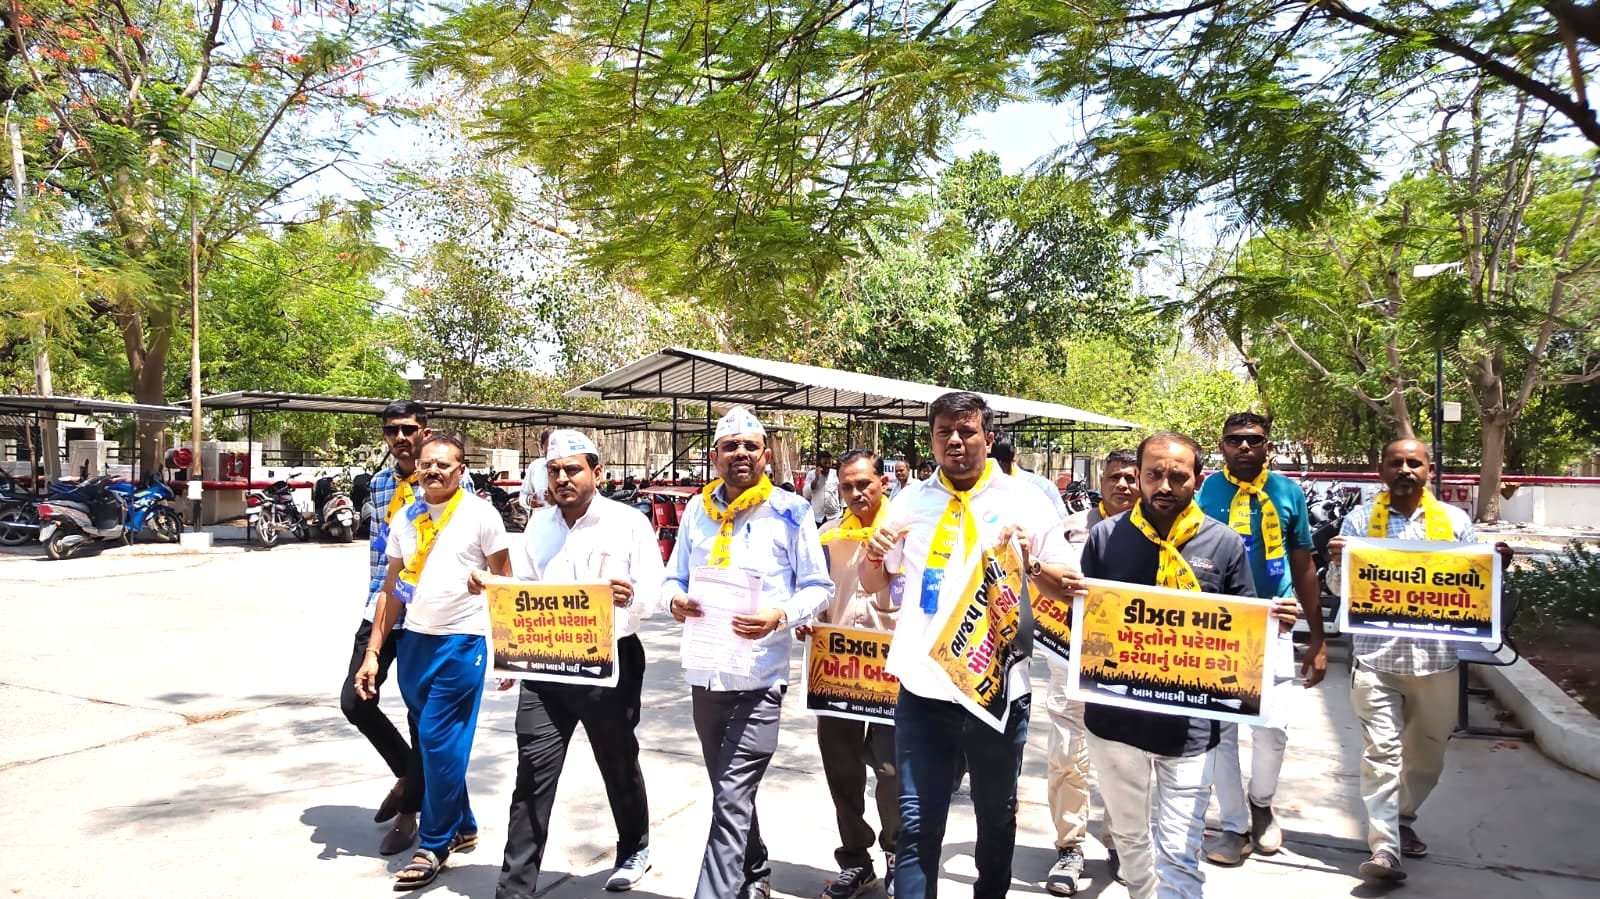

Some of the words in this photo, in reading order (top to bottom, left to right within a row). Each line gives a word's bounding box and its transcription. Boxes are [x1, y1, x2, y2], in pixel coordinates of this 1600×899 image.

[1358, 564, 1426, 585] મોંઘવારી
[1432, 569, 1486, 590] હટાવો,
[515, 590, 559, 612] ડીઝલ
[562, 589, 590, 610] માટે
[1370, 582, 1401, 604] દેશ
[1406, 587, 1478, 609] બચાવો.
[512, 612, 556, 632] ખેડૂતોને
[558, 612, 597, 627] પરેશાન
[1123, 598, 1185, 627] ડીઝલ
[1191, 606, 1232, 631] માટે
[517, 630, 554, 648] કરવાનું
[555, 630, 573, 643] બંધ
[950, 604, 984, 658] ભાજપ
[1117, 626, 1177, 652] ખેડૂતોને
[1181, 631, 1240, 653] પરેશાન
[829, 632, 878, 658] ડિઝલ
[823, 654, 860, 680] ખેતી
[1119, 650, 1170, 672] કરવાનું
[1173, 653, 1201, 669] બંધ
[1132, 688, 1152, 698] આમ
[1154, 690, 1185, 702] આદમી
[1187, 693, 1208, 705] પાર્ટી
